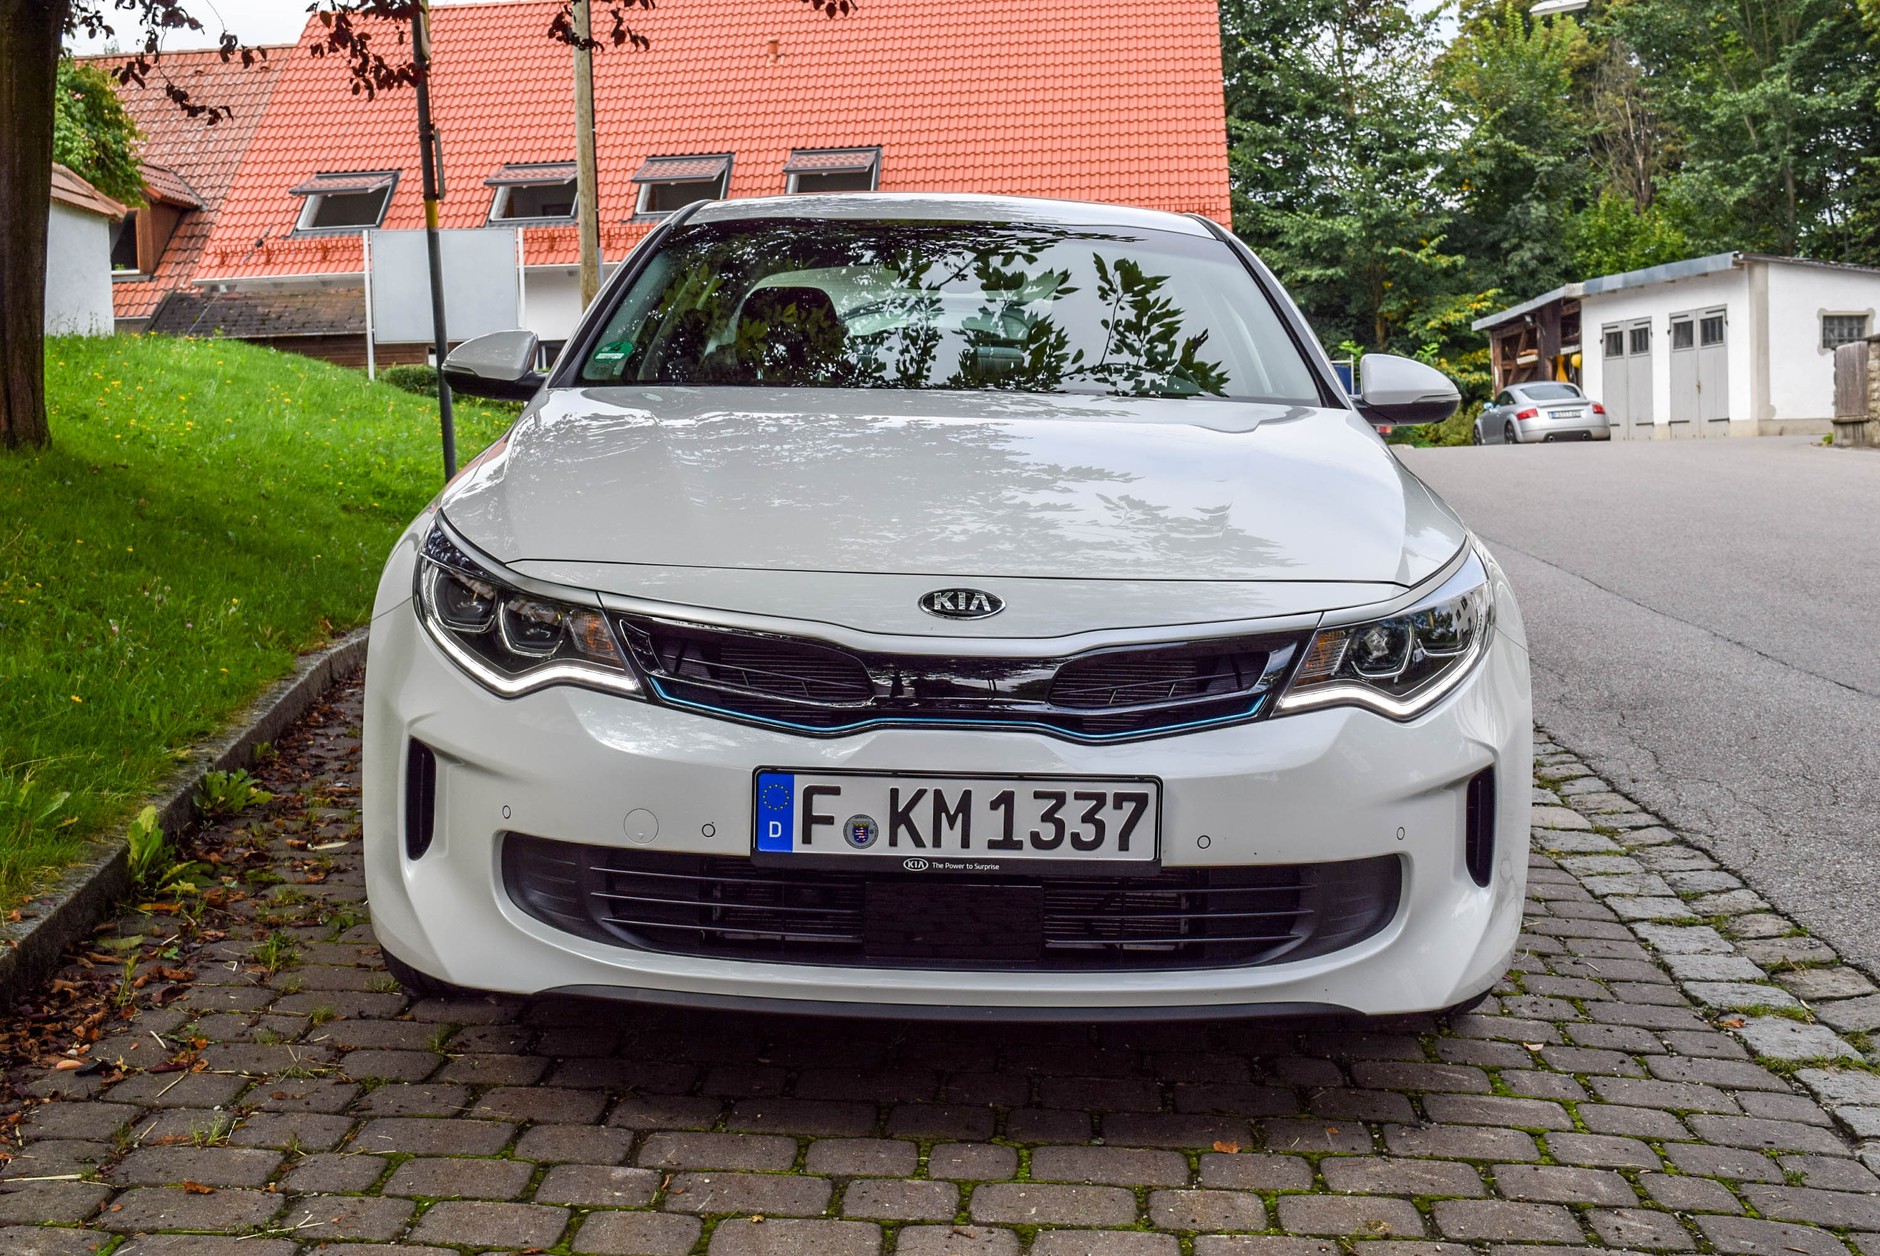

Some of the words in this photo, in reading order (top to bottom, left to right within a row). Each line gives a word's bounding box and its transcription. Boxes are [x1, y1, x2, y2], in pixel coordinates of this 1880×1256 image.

[933, 591, 992, 611] KIA
[802, 785, 841, 844] F
[888, 787, 972, 849] KM
[987, 789, 1149, 851] 1337
[768, 821, 782, 838] D
[945, 862, 965, 870] Power
[974, 862, 1000, 871] Surprise
